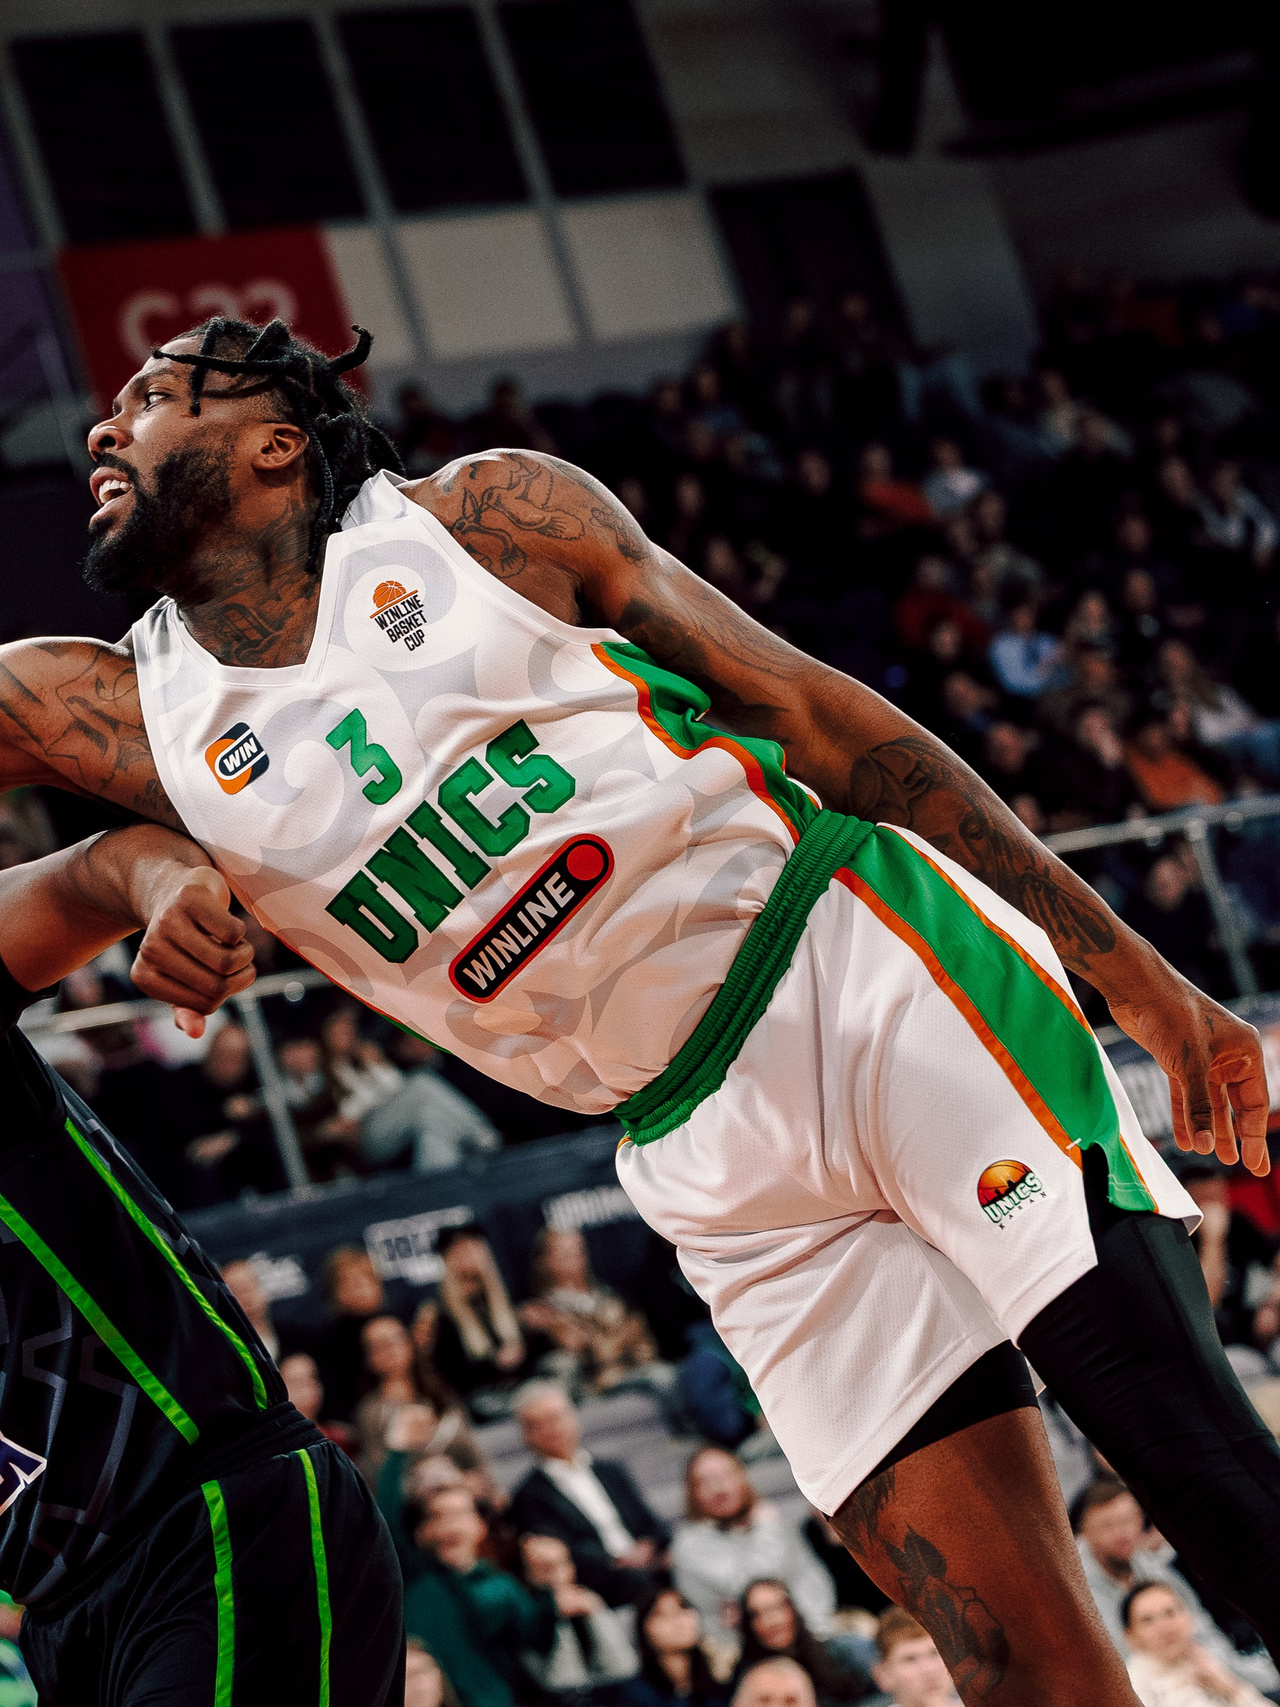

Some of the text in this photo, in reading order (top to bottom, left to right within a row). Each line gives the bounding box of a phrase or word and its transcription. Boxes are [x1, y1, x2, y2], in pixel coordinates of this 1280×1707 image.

[374, 594, 424, 631] WINLINE
[386, 609, 427, 643] BASKET
[404, 628, 425, 652] CUP
[222, 737, 258, 773] WIN
[325, 707, 403, 805] 3
[325, 718, 576, 964] UNICS
[462, 871, 575, 991] WINLINE
[983, 1172, 1043, 1223] UNICS
